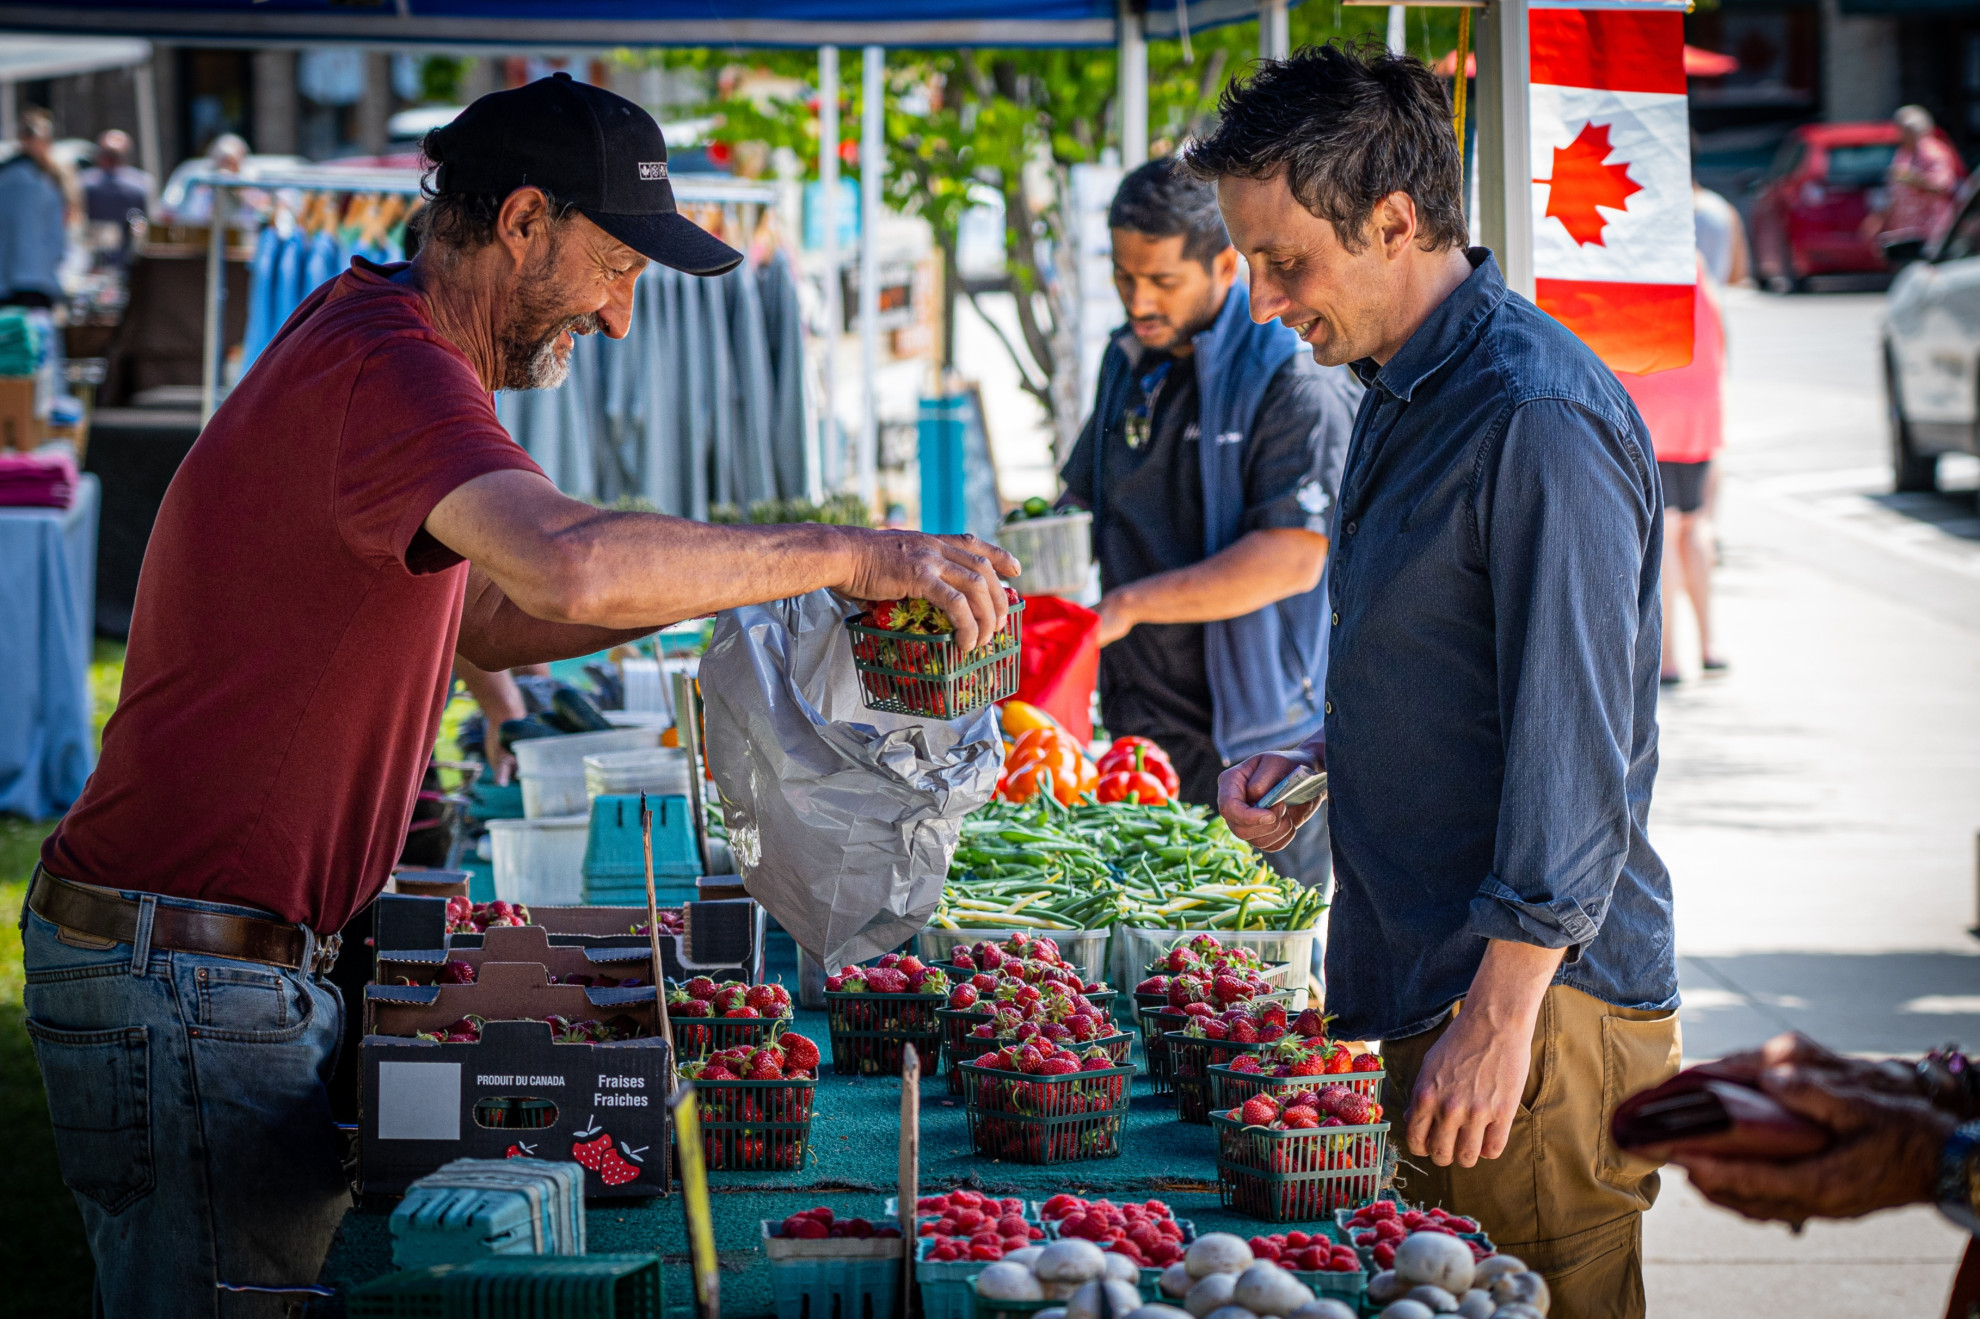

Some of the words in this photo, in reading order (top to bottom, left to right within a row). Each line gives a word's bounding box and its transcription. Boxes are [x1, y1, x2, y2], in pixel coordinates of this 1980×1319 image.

[477, 1075, 514, 1086] PRODUIT
[515, 1075, 528, 1086] DU
[529, 1075, 565, 1086] CANADA
[598, 1074, 645, 1088] Fraises
[594, 1093, 648, 1107] Fraiches
